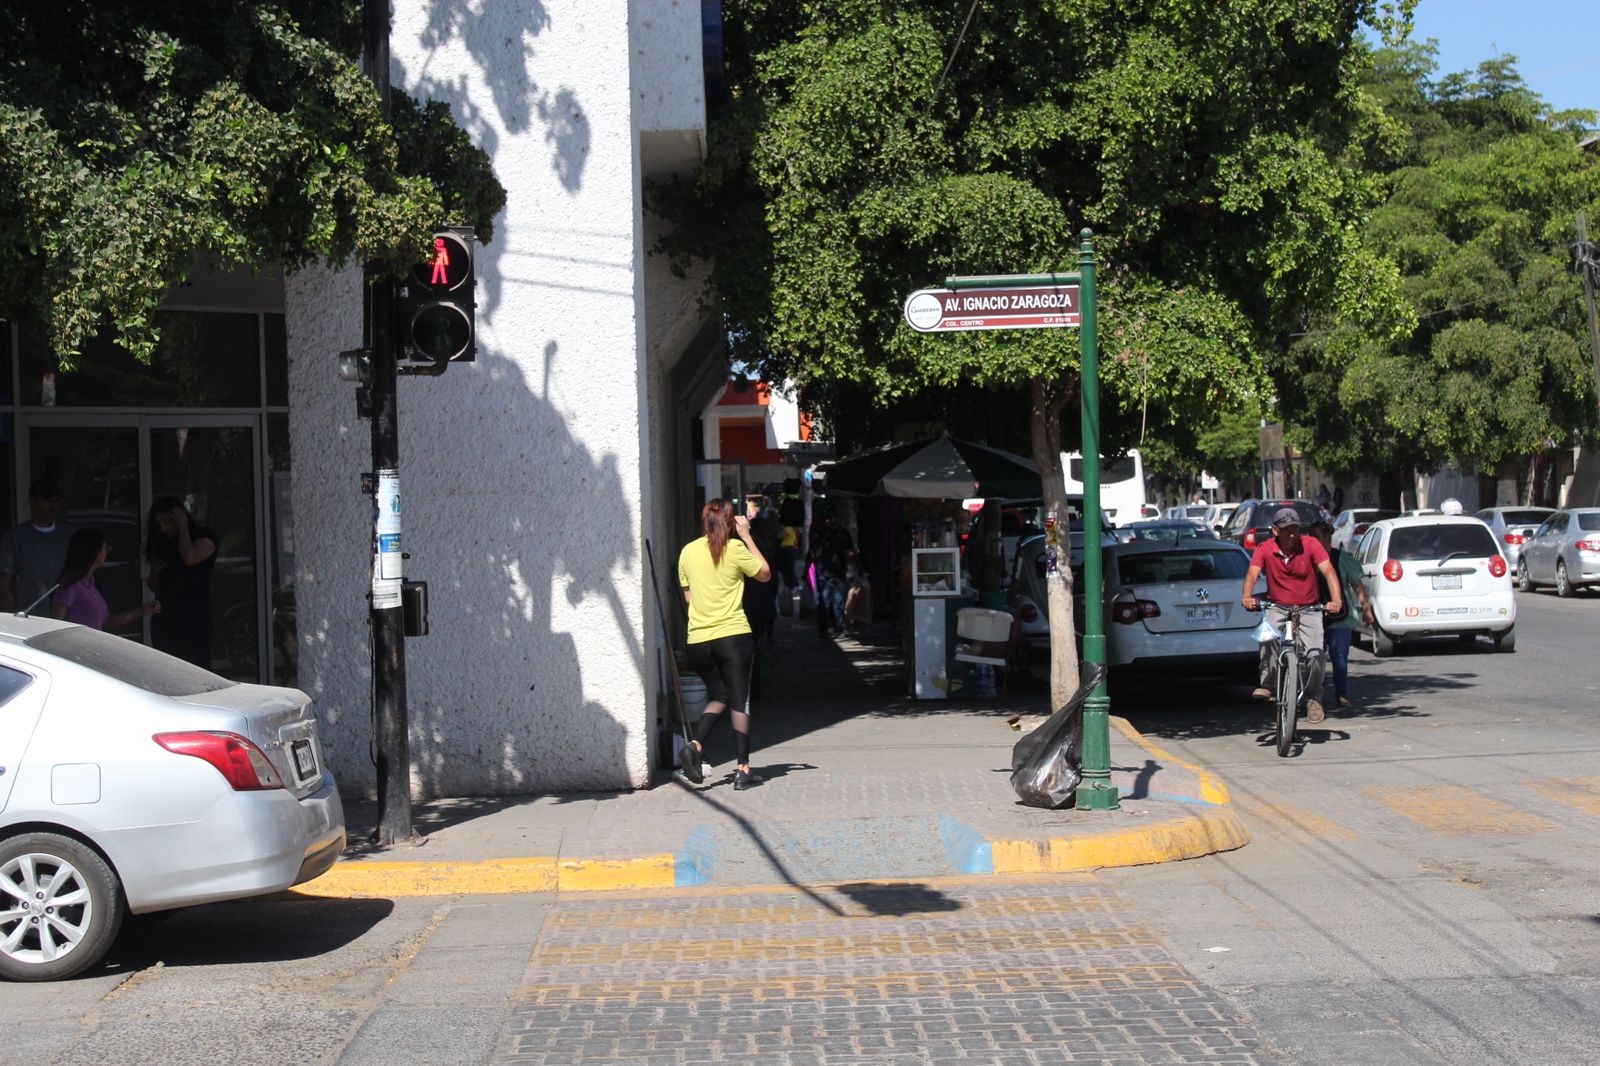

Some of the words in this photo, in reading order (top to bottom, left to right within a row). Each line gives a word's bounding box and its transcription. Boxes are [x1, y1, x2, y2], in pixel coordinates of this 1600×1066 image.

[945, 299, 961, 311] AV.
[963, 295, 1009, 311] IGNACIO
[1011, 293, 1072, 309] ZARAGOZA
[960, 319, 984, 327] CENTRO
